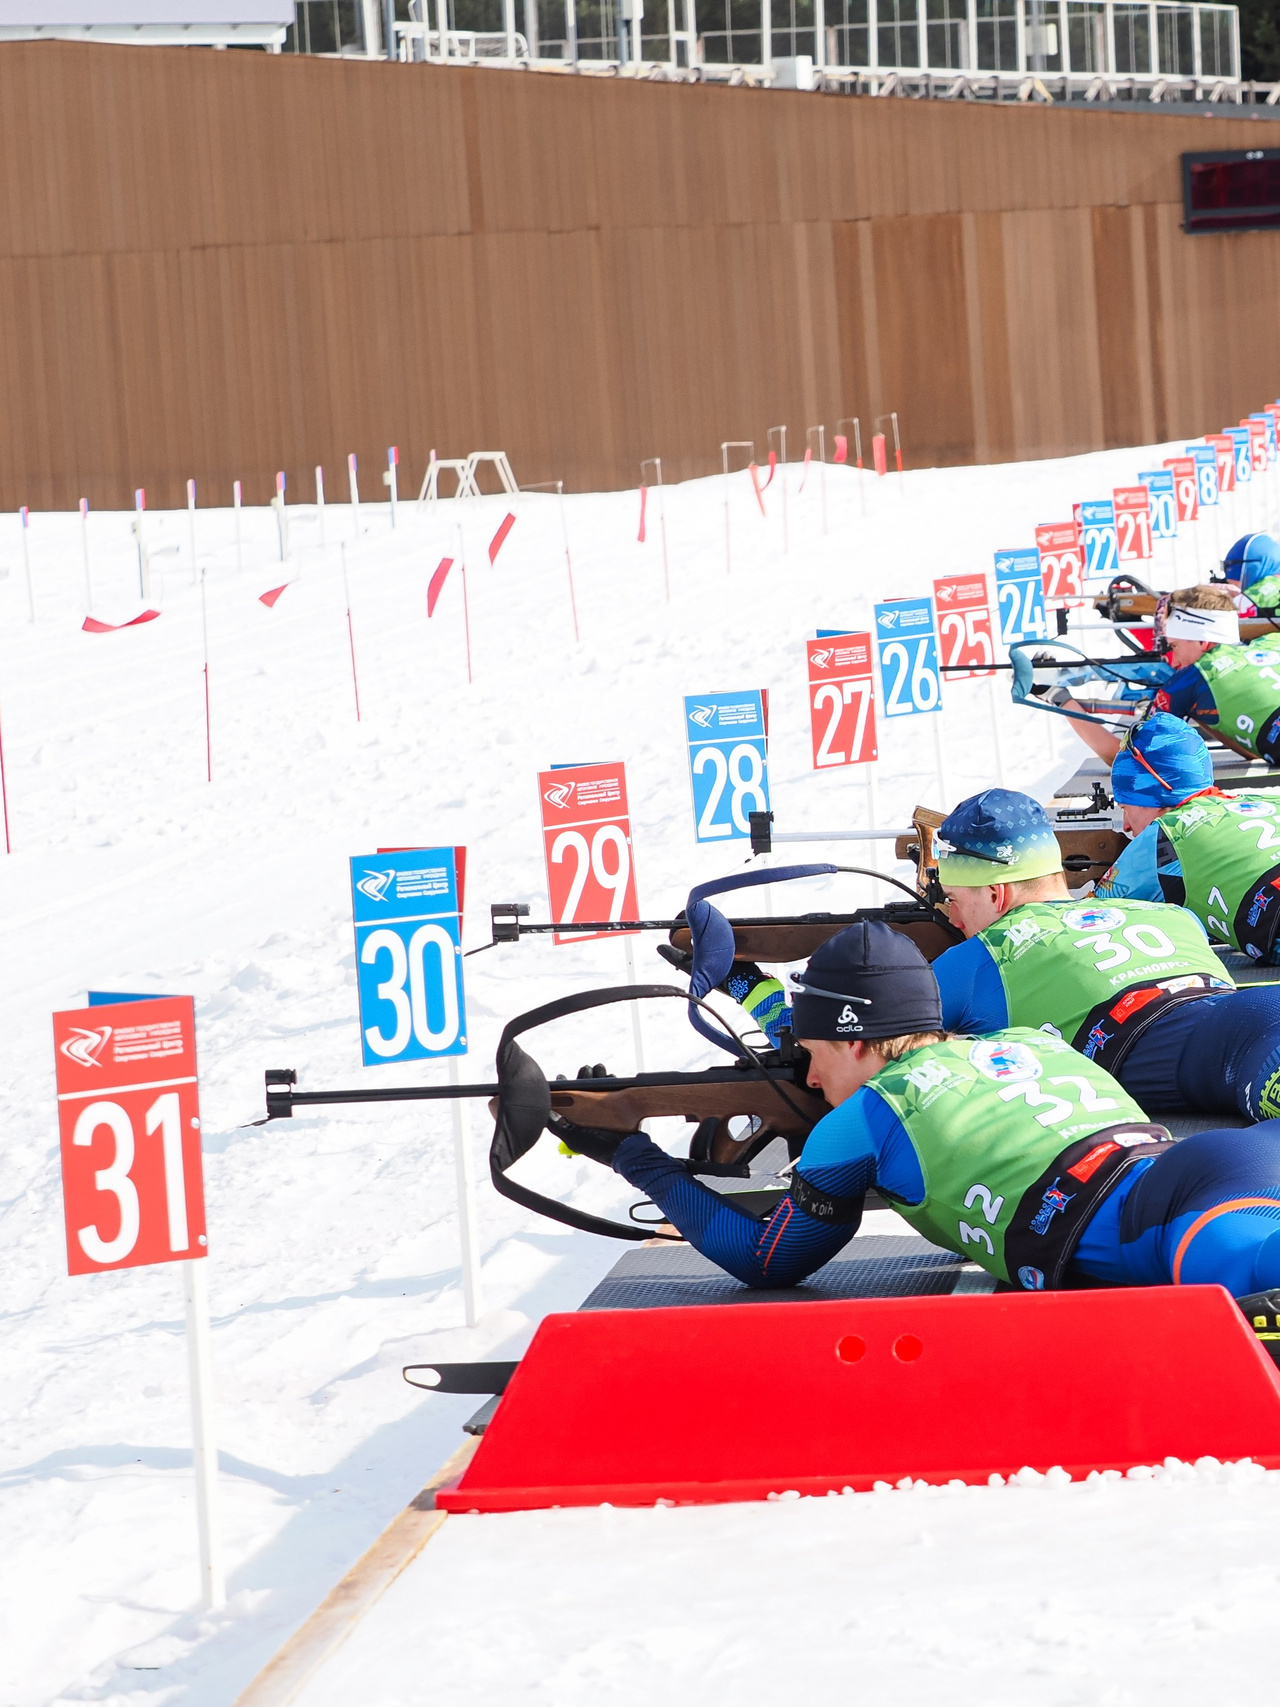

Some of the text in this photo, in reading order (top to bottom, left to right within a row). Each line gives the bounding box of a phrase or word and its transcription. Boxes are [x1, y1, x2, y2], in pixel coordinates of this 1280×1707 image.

[1218, 455, 1232, 491] 7
[1236, 446, 1251, 482] 6
[1252, 437, 1267, 471] 5
[1178, 479, 1196, 521] 9
[1199, 466, 1217, 505] 8
[1085, 528, 1117, 578] 22
[1117, 511, 1151, 559] 21
[1042, 553, 1081, 610] 23
[999, 581, 1045, 642] 24
[940, 610, 992, 679] 25
[882, 638, 939, 716] 26
[813, 679, 872, 766] 27
[1235, 714, 1255, 749] 19
[692, 742, 768, 840] 28
[551, 824, 631, 944] 29
[1207, 885, 1231, 937] 27
[1072, 924, 1177, 972] 30
[1109, 961, 1190, 986] КРАСНОЯРСК
[360, 924, 460, 1058] 30
[836, 1025, 864, 1033] odlo
[997, 1075, 1122, 1128] 32
[73, 1092, 189, 1264] 31
[958, 1183, 1005, 1255] 32
